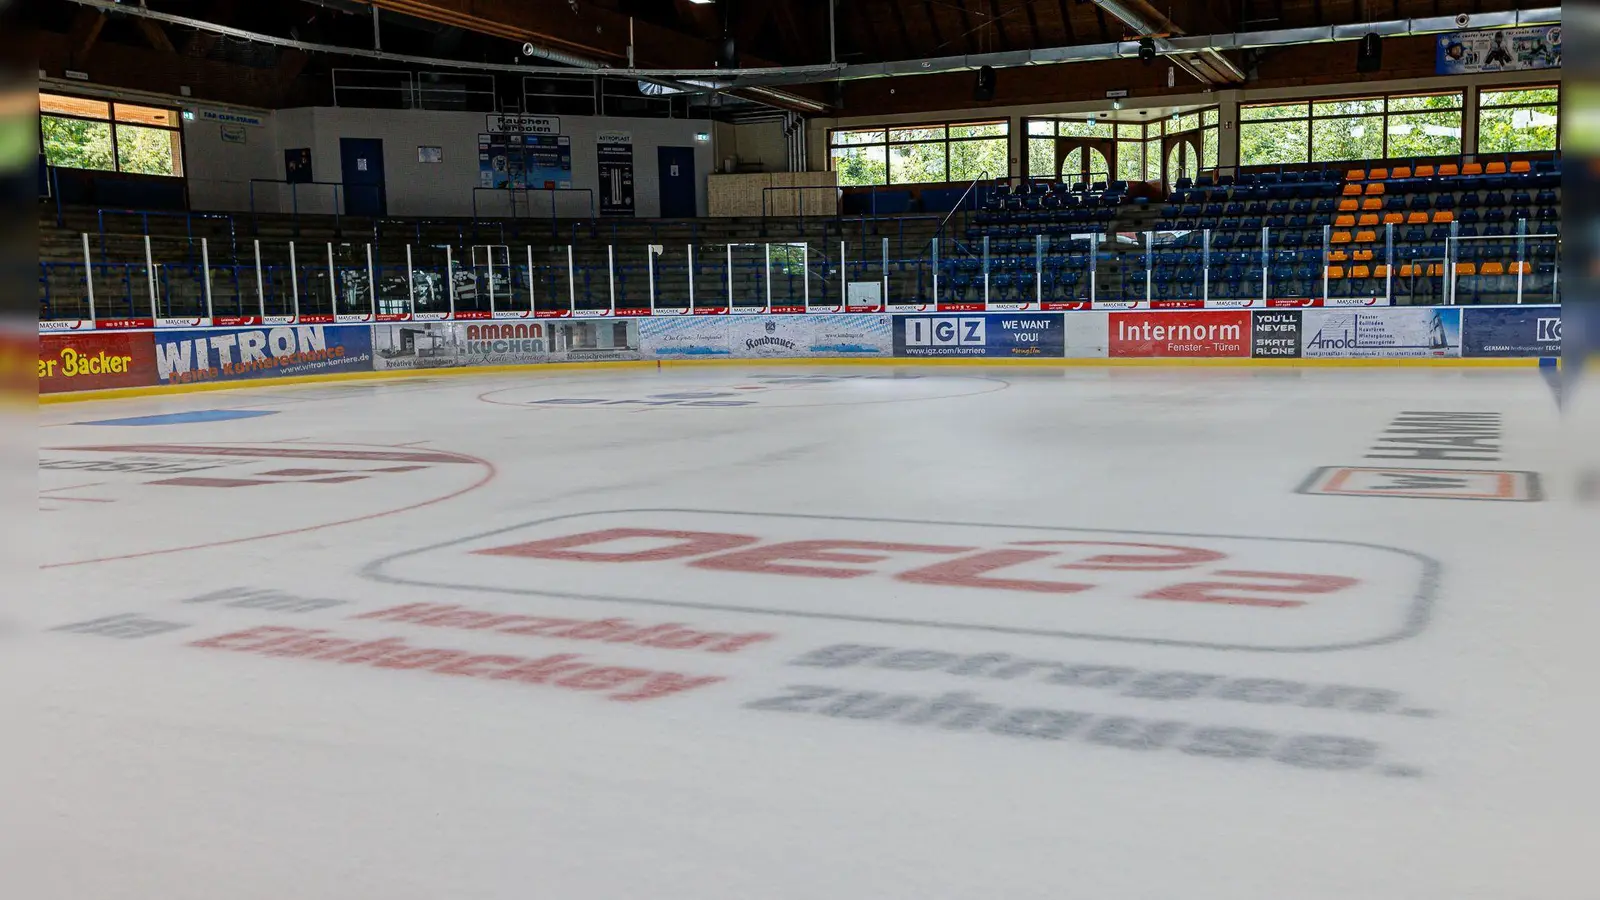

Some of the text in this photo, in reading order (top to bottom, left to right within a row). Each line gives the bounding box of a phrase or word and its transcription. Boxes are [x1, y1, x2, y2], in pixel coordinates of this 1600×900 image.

[497, 117, 550, 126] Rauchen
[497, 125, 552, 134] Verboten
[39, 321, 69, 329] MASCHEK
[1001, 320, 1050, 329] WE WANT
[1257, 315, 1297, 323] YOU'LL
[467, 324, 542, 340] AMANN
[1119, 321, 1240, 341] Internorm
[1256, 324, 1296, 332] NEVER
[746, 335, 796, 350] Kondrauer
[1013, 333, 1039, 342] YOU!
[1307, 328, 1357, 349] Arnold
[156, 326, 325, 380] WITRON
[906, 347, 986, 355] www.igz.com/karriere
[1168, 343, 1202, 352] Fenster
[1213, 343, 1240, 351] Türen
[60, 347, 132, 377] Bäcker
[169, 345, 345, 385] Deine Karrierechance
[279, 353, 370, 375] www.witron-karriere.de
[386, 359, 412, 368] Kreative
[352, 601, 776, 653] Herzblut
[785, 643, 1434, 718] getragen.
[190, 625, 727, 702] Eishockey
[742, 684, 1424, 777] zuhause.
